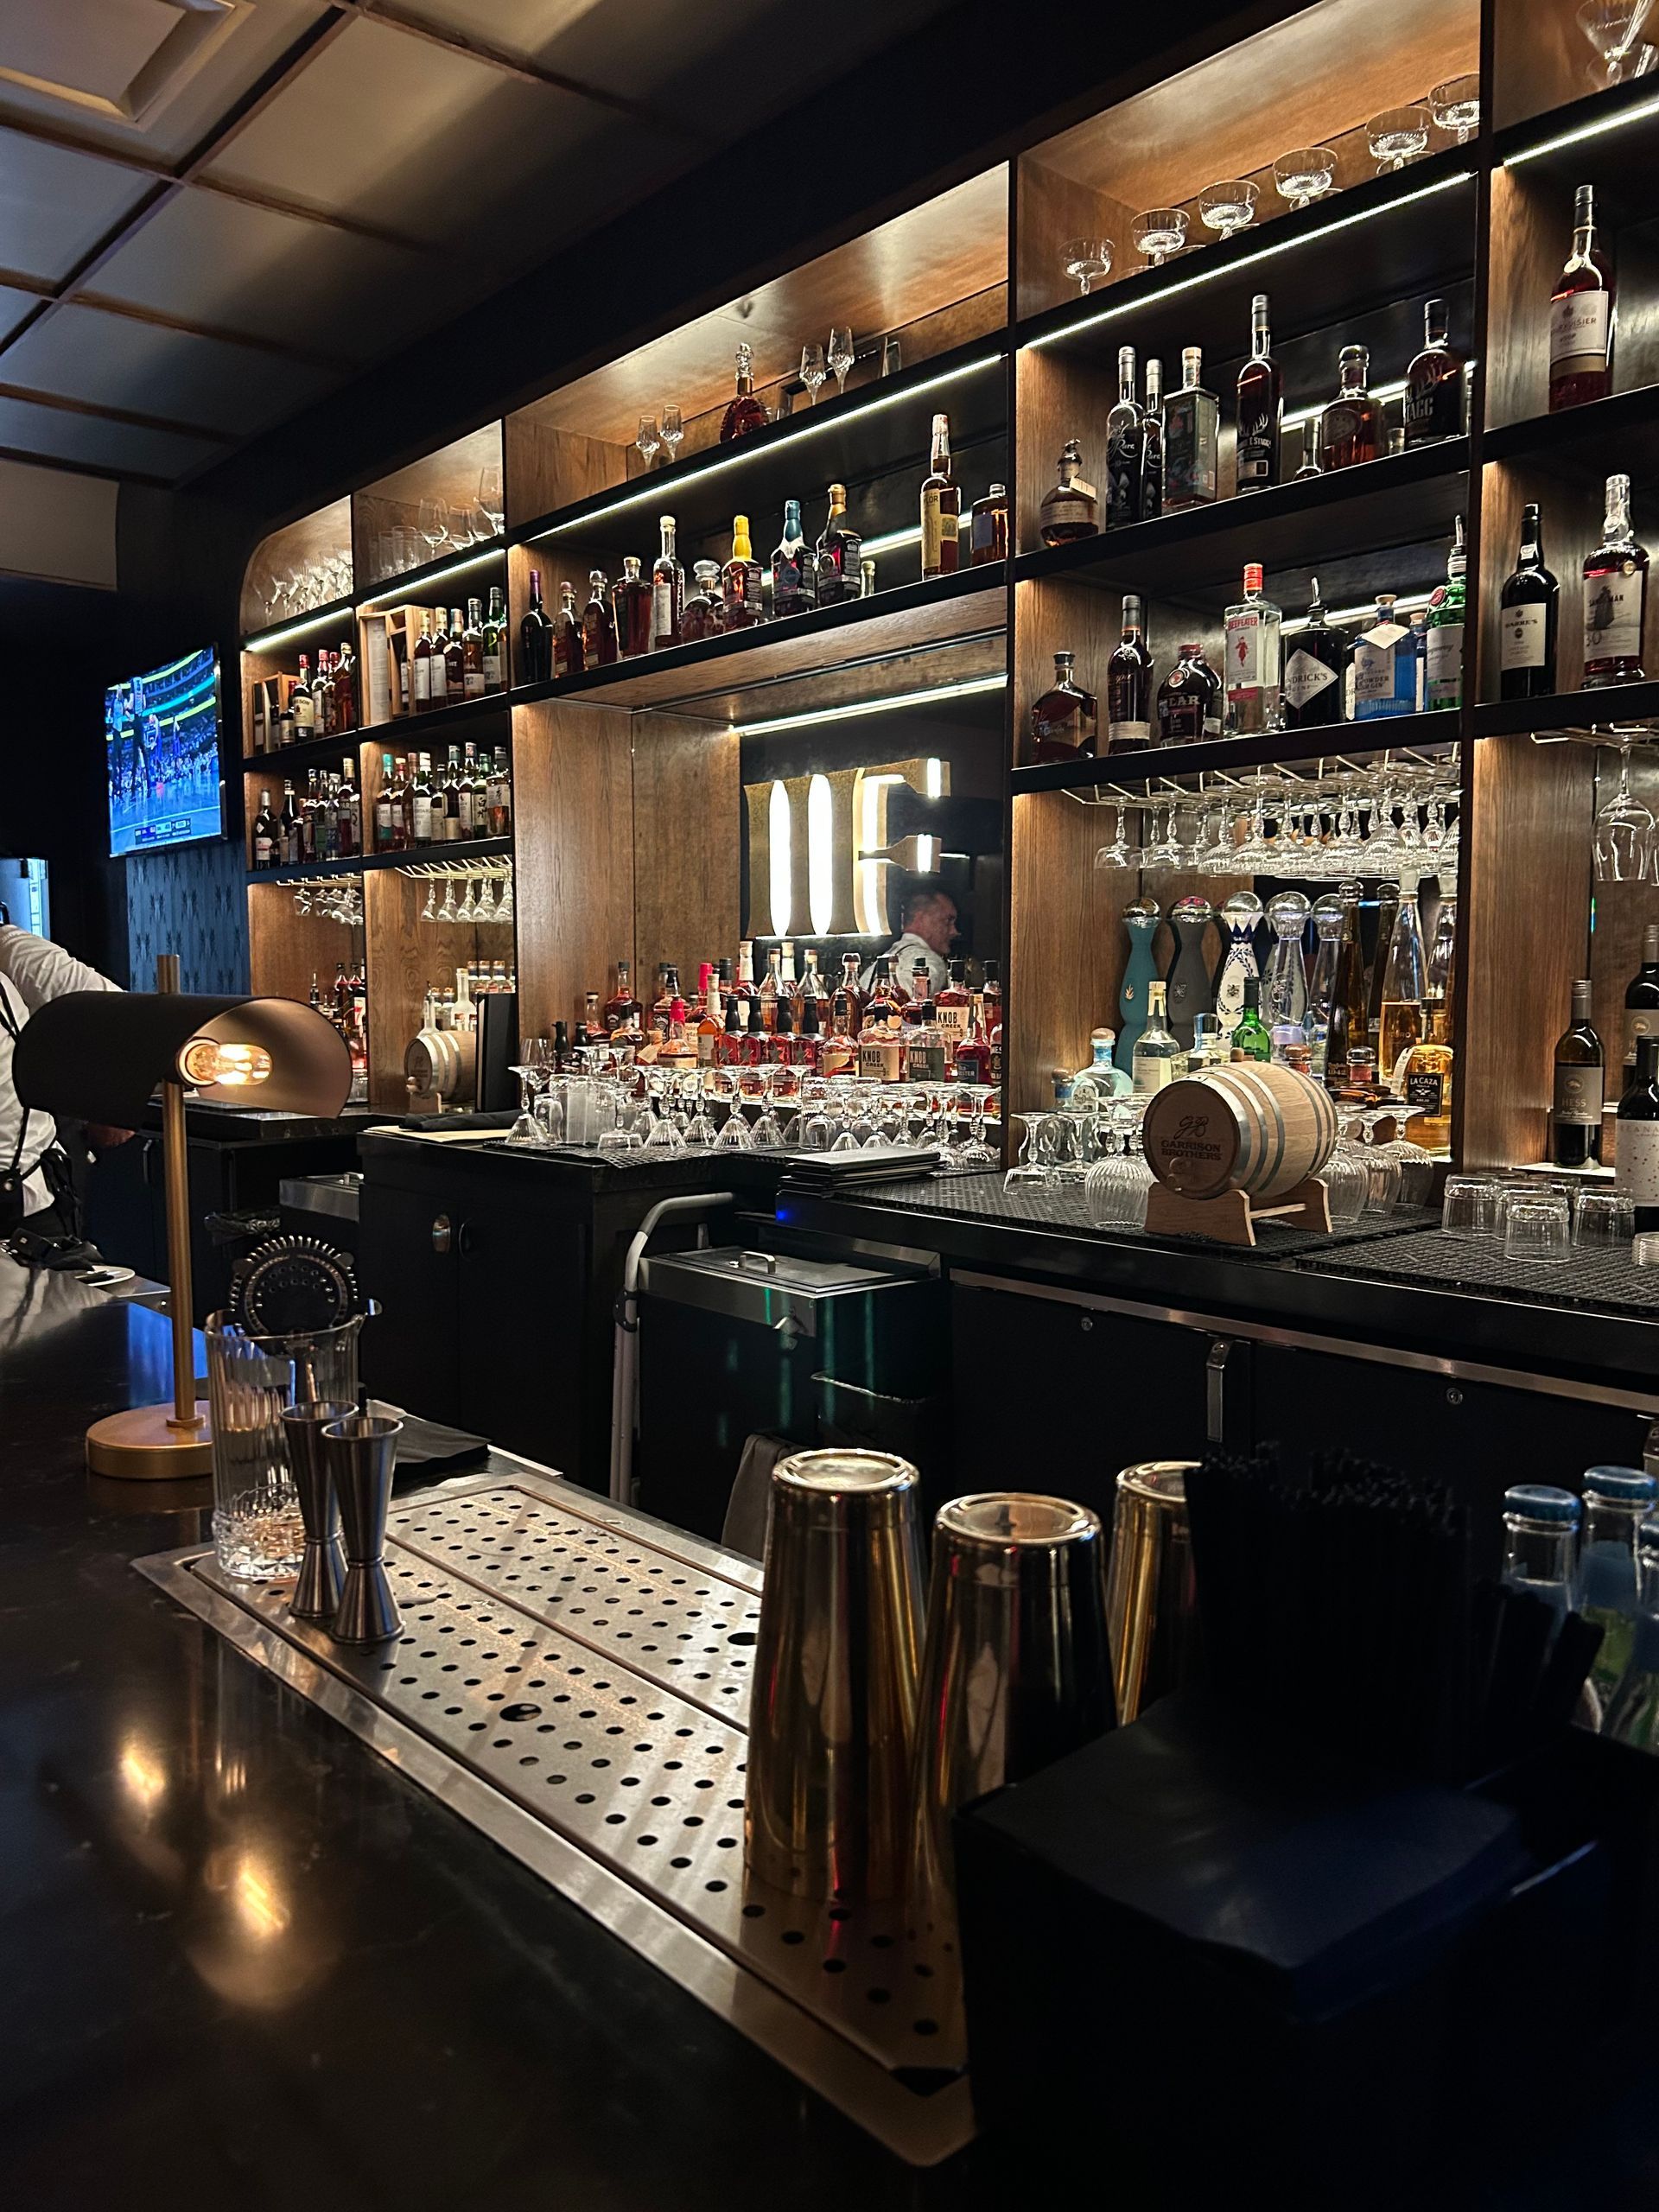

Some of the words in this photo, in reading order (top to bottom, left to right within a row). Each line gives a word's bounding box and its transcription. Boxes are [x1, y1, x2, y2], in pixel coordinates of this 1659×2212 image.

[1227, 616, 1258, 631] BEEFEATER
[1286, 672, 1327, 685] NDRICK'S
[938, 1011, 957, 1024] KNOB
[862, 1050, 880, 1062] KNOB
[910, 1050, 927, 1063] KNOB
[1419, 1077, 1438, 1086] CAZA
[1561, 1098, 1586, 1107] HESS
[1160, 1140, 1221, 1153] GARRISON
[1160, 1148, 1222, 1161] BROTHERS
